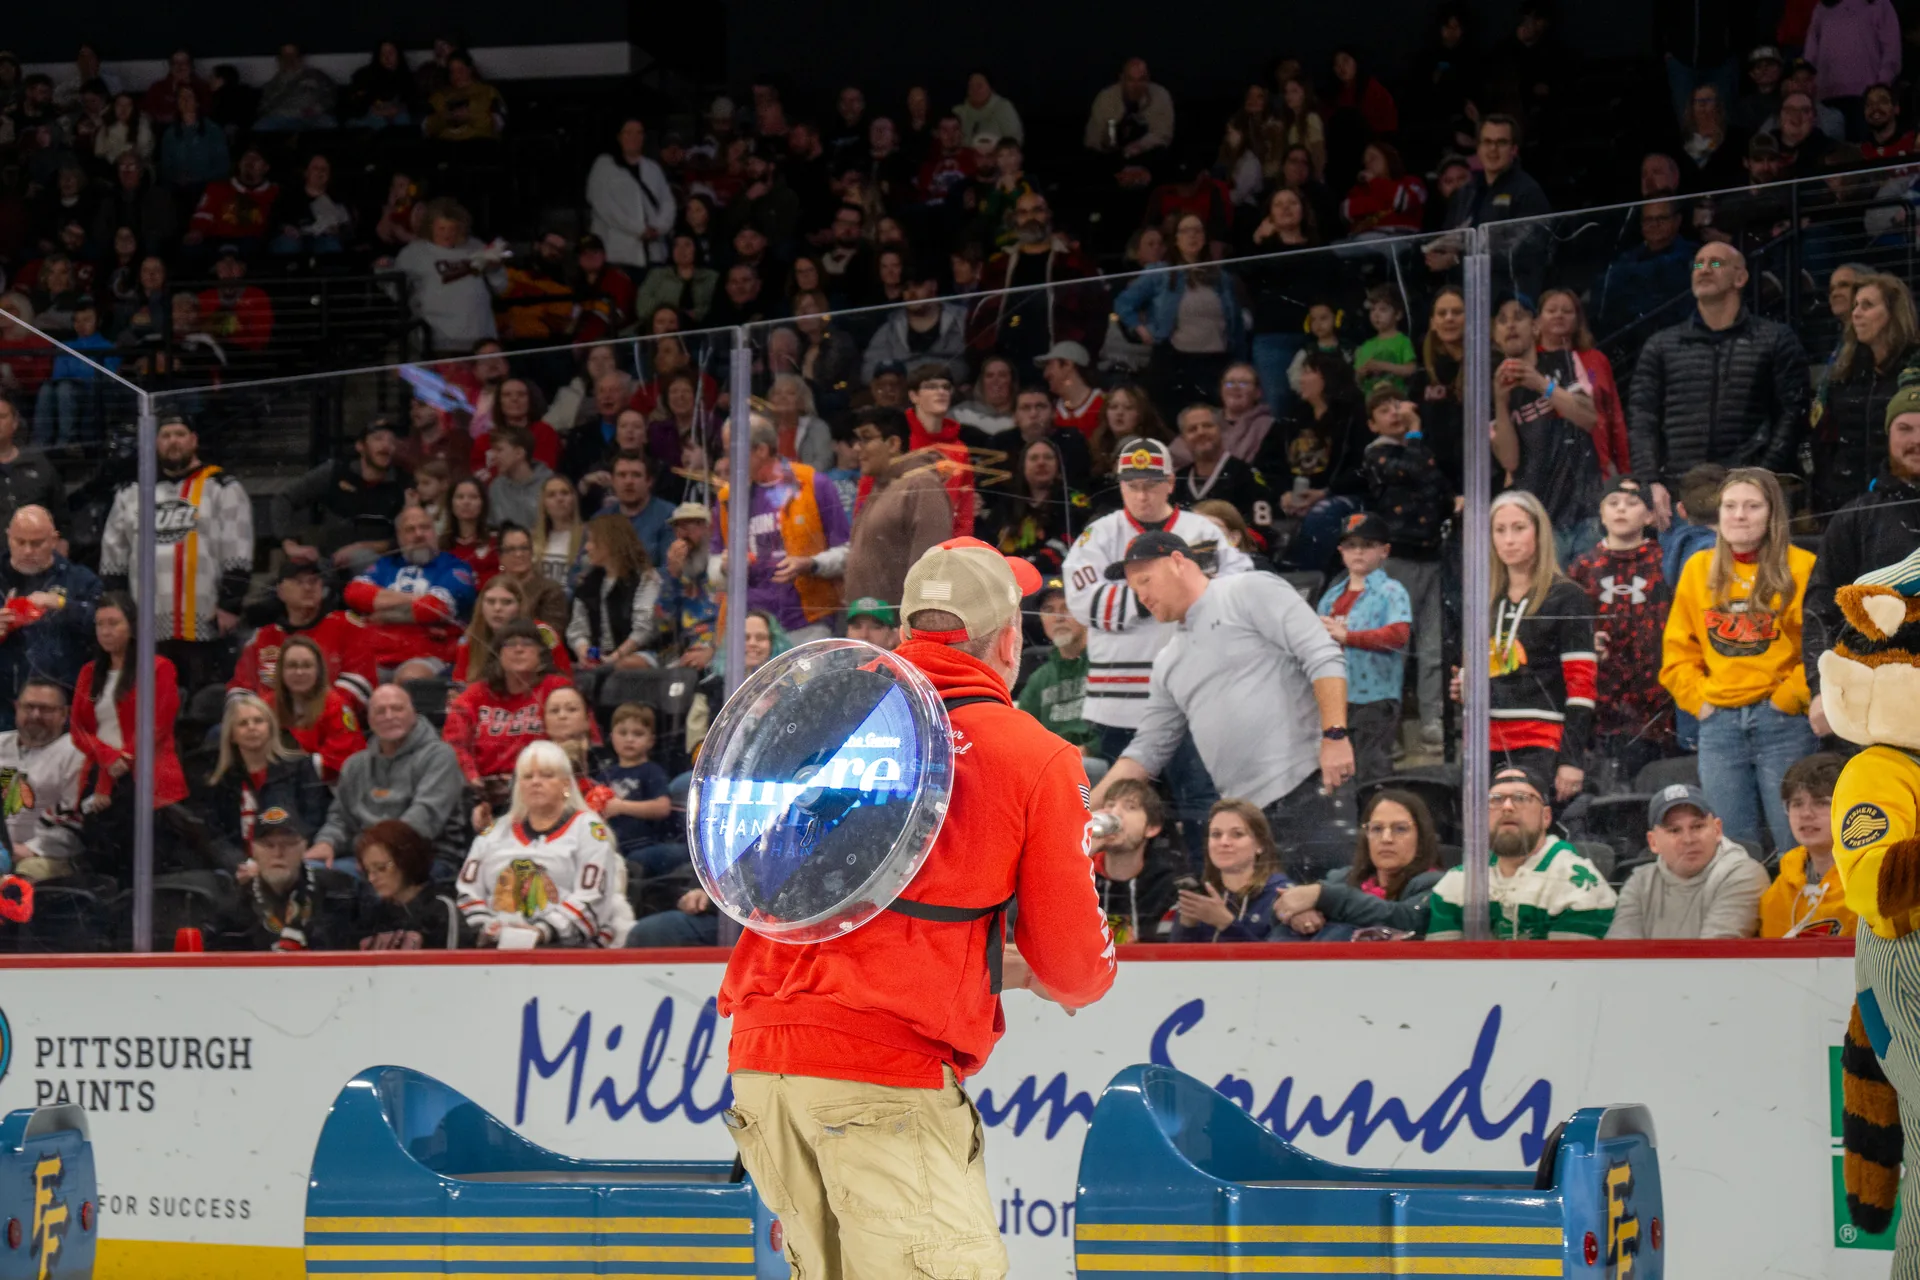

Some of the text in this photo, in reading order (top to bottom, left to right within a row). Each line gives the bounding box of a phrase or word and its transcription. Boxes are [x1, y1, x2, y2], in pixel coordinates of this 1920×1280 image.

[154, 507, 196, 530] UEL
[35, 1037, 253, 1070] PITTSBURGH
[35, 1080, 156, 1112] PAINTS
[97, 1195, 252, 1220] FOR SUCCESS
